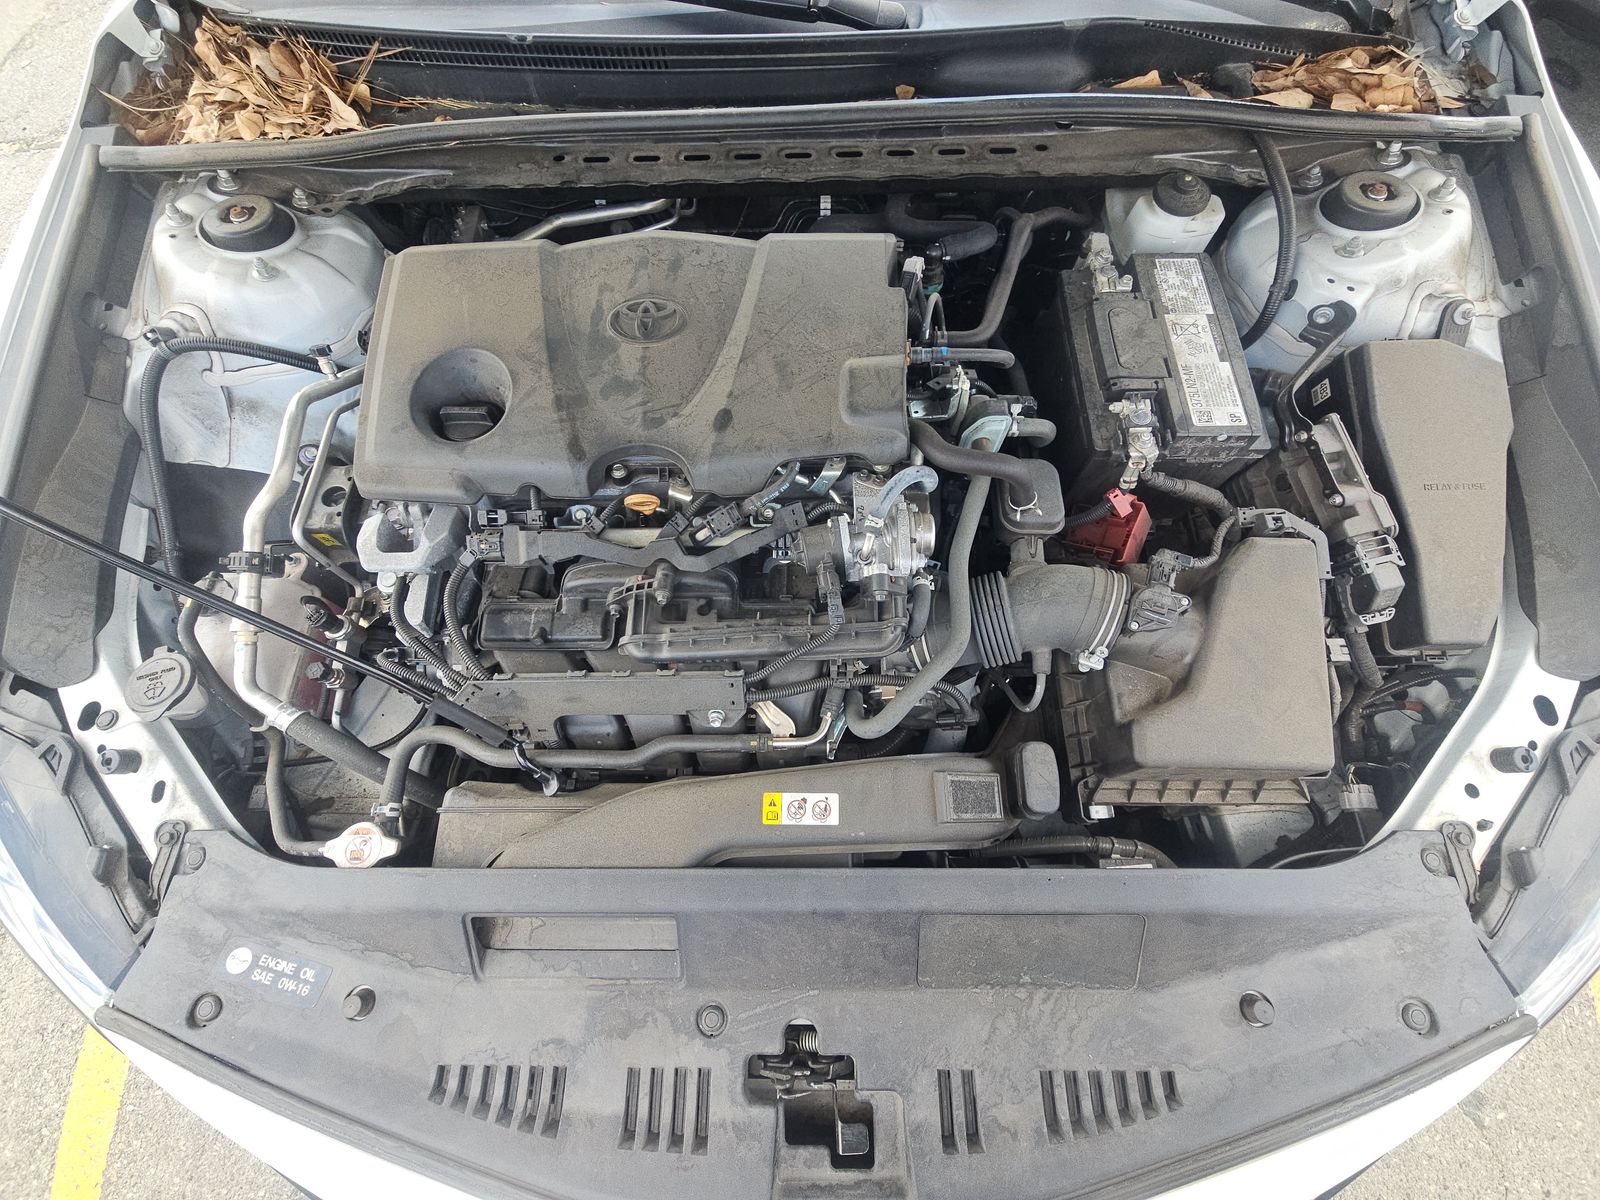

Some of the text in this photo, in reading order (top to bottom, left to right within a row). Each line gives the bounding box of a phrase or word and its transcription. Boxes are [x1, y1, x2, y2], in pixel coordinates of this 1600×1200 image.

[1181, 363, 1203, 408] 375LN2-MF
[1319, 382, 1329, 400] 4B3
[1229, 413, 1243, 424] SP
[1423, 483, 1452, 491] RELAY
[1462, 482, 1487, 491] FUSE
[258, 954, 316, 982] ENGINE OIL
[251, 968, 311, 997] SAE 0W-16
